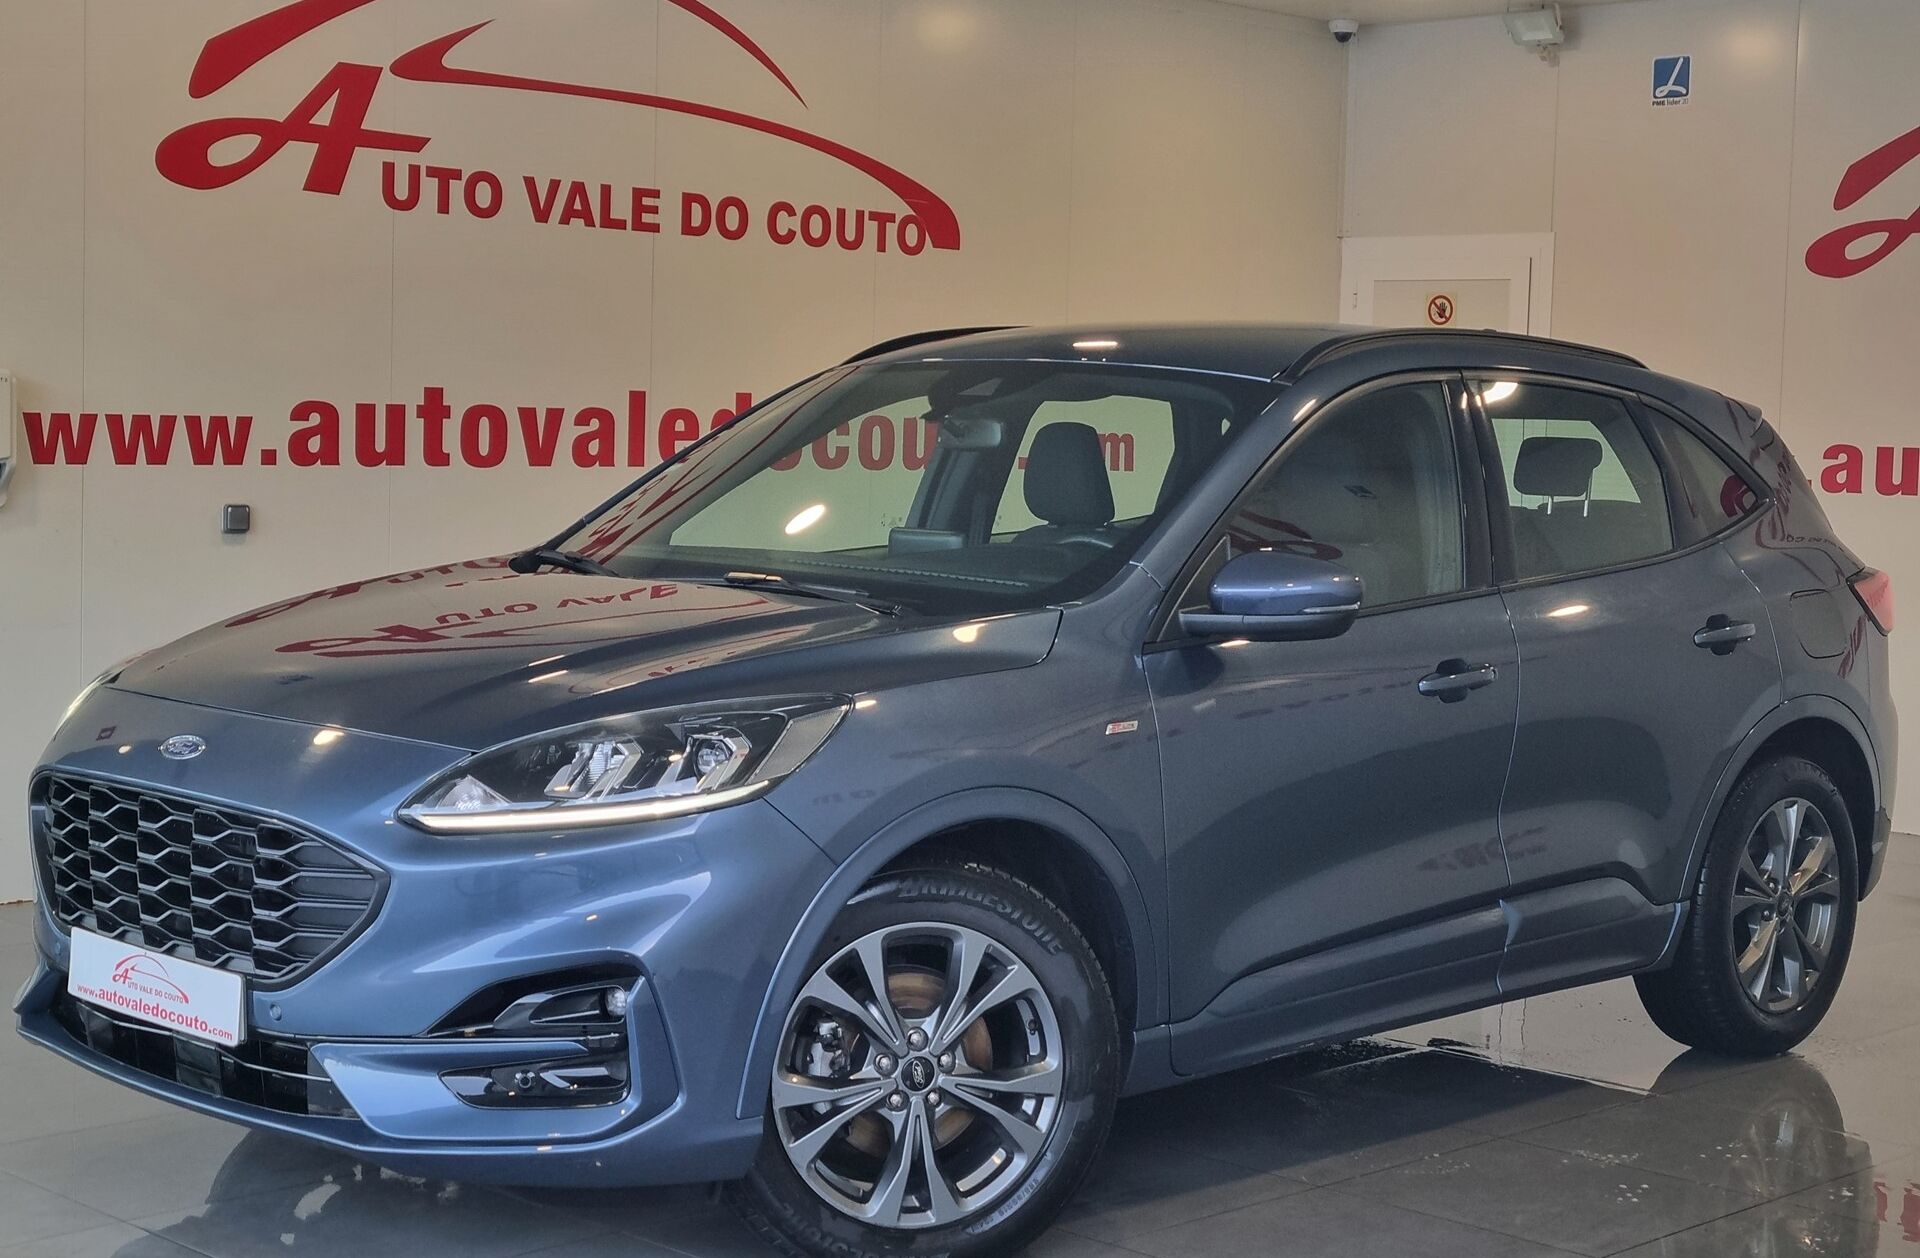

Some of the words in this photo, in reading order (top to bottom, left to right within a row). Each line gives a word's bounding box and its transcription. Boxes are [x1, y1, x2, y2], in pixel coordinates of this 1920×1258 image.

[523, 175, 661, 233] VALE
[681, 191, 749, 241] DO
[766, 200, 927, 256] COUTO
[77, 983, 233, 1041] www.autovaledocouto.com
[138, 984, 153, 995] VALE
[154, 988, 164, 997] DO
[164, 991, 184, 1004] COUTO
